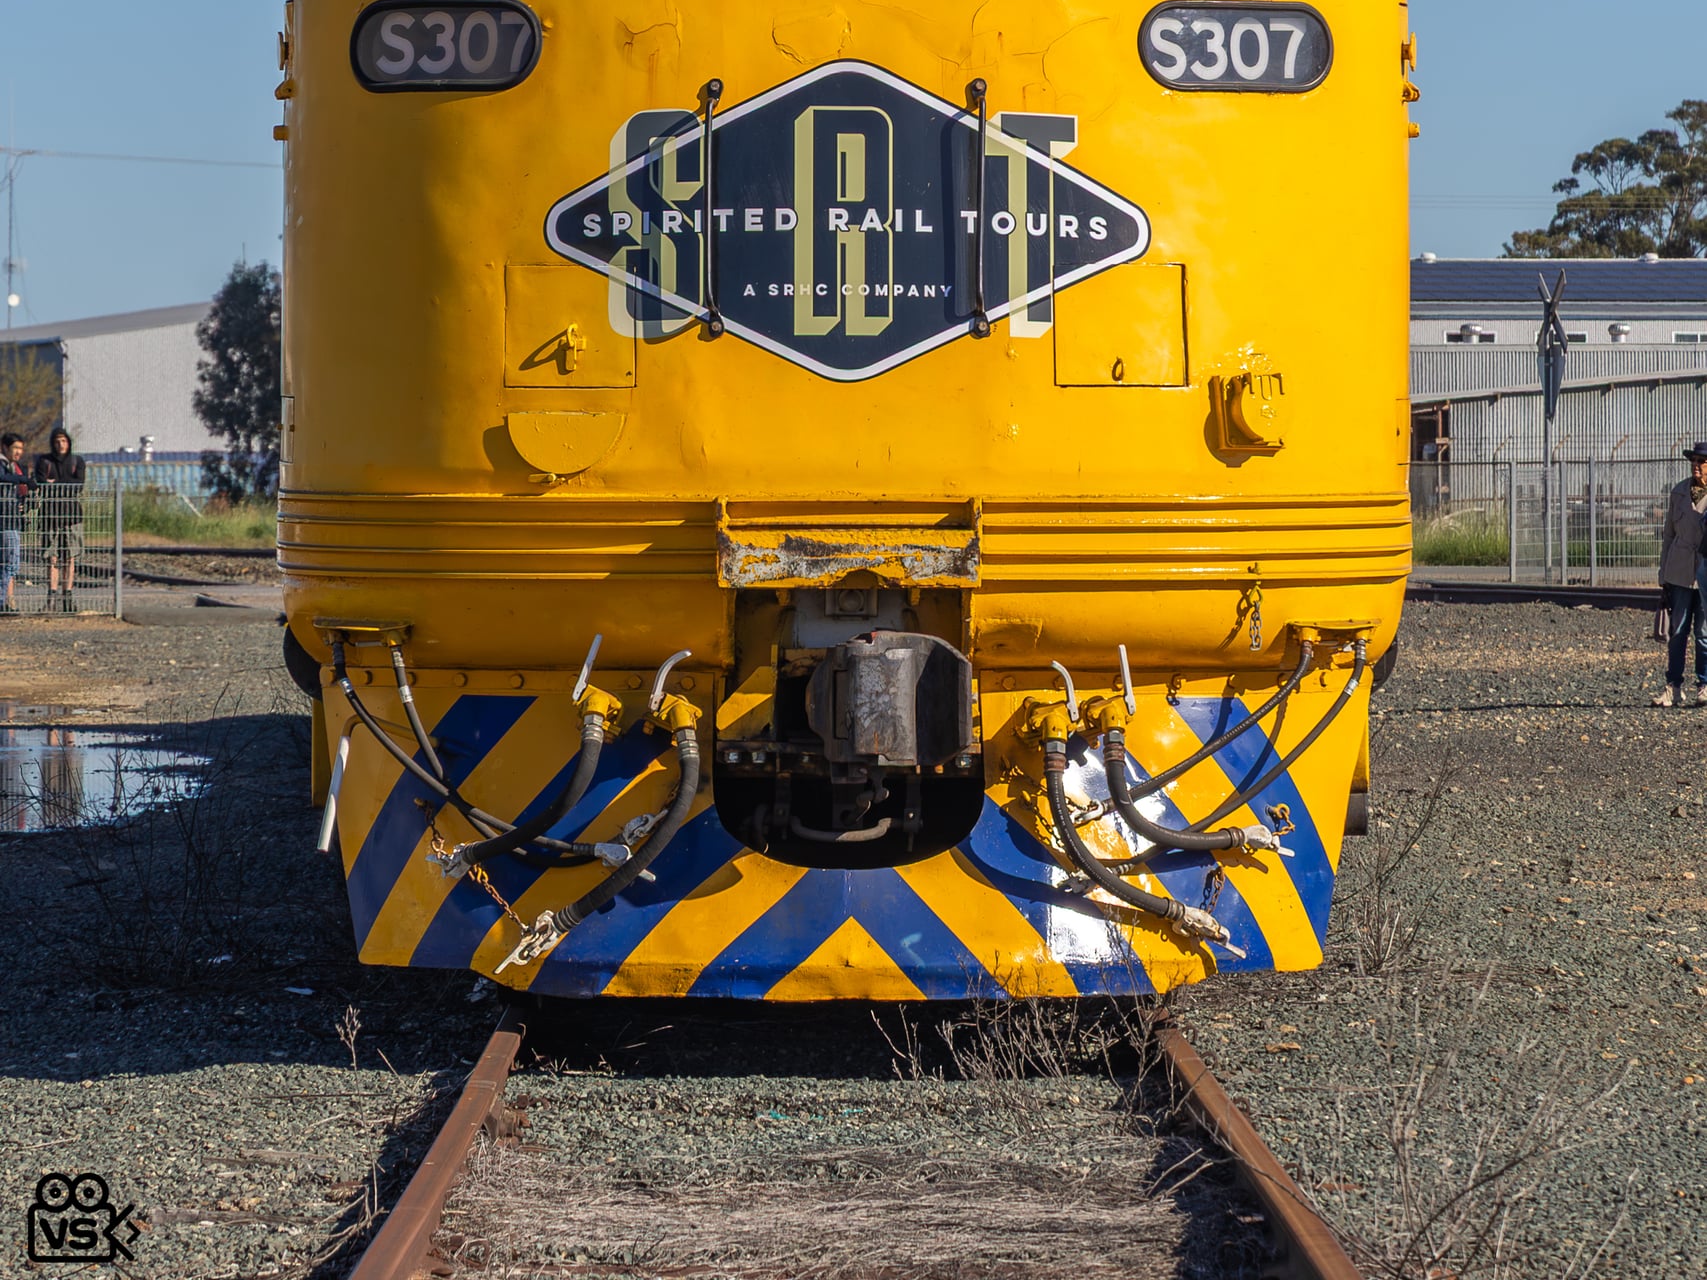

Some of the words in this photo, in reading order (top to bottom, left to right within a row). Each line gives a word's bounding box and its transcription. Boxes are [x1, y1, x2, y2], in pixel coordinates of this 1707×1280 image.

[376, 11, 532, 75] S307
[1150, 17, 1304, 80] S307
[583, 207, 799, 237] SPIRITED
[828, 207, 933, 233] RAIL
[960, 210, 1108, 240] TOURS
[608, 106, 1077, 338] SRT
[743, 283, 756, 297] A
[768, 283, 828, 297] SRHC
[841, 283, 952, 298] COMPANY
